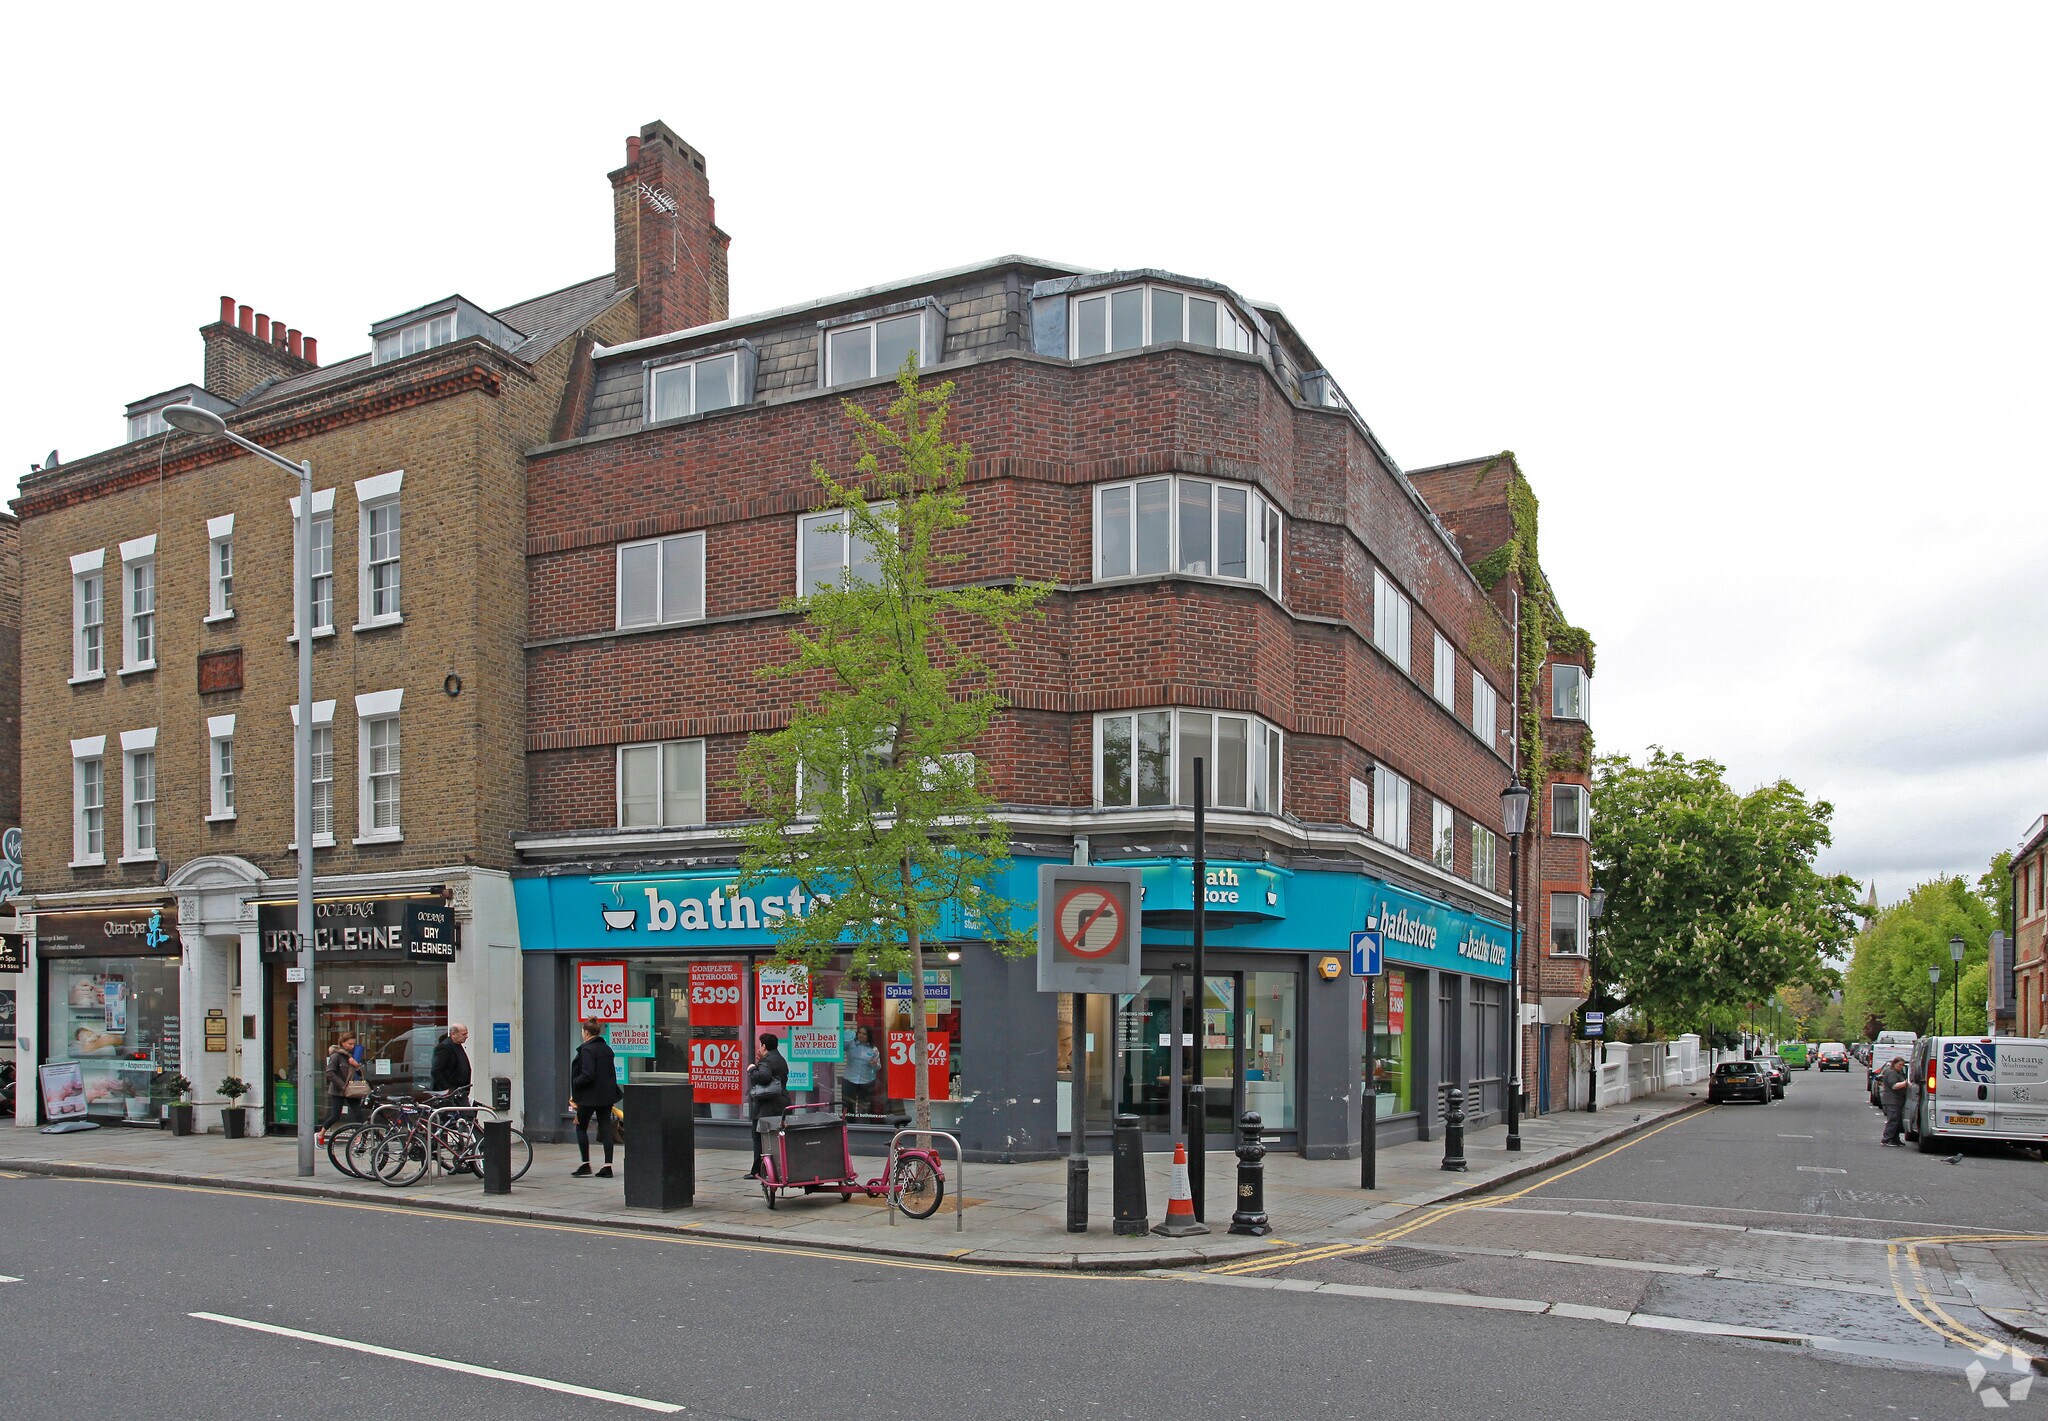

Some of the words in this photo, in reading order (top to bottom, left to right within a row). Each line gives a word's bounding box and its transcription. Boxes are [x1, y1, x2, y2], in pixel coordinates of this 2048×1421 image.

[1192, 867, 1239, 886] ath
[1192, 889, 1239, 904] tore
[317, 902, 375, 918] OCEANA
[645, 884, 898, 931] bathst
[418, 912, 445, 923] OCEANA
[104, 921, 129, 938] Quan
[129, 920, 147, 938] Spa
[1380, 901, 1437, 950] bathstore
[315, 925, 402, 951] CLEANE
[424, 926, 439, 939] DRY
[410, 941, 453, 955] CLEANERS
[5, 955, 16, 963] Spa
[939, 973, 949, 982] &
[582, 980, 622, 998] price
[692, 986, 740, 1004] £399
[761, 980, 807, 1000] price
[887, 986, 949, 998] Splasanels
[612, 1029, 630, 1037] we'll
[632, 1029, 649, 1037] beat
[794, 1033, 815, 1041] we'll
[817, 1033, 837, 1041] beat
[890, 1032, 904, 1041] UP
[691, 1043, 740, 1067] 10%
[2001, 1054, 2043, 1064] Mustang
[721, 1059, 740, 1068] OFF
[928, 1057, 947, 1066] OFF
[691, 1075, 740, 1083] SPLASHPANELS
[691, 1082, 718, 1090] IMITED
[1949, 1116, 1969, 1124] BJ60
